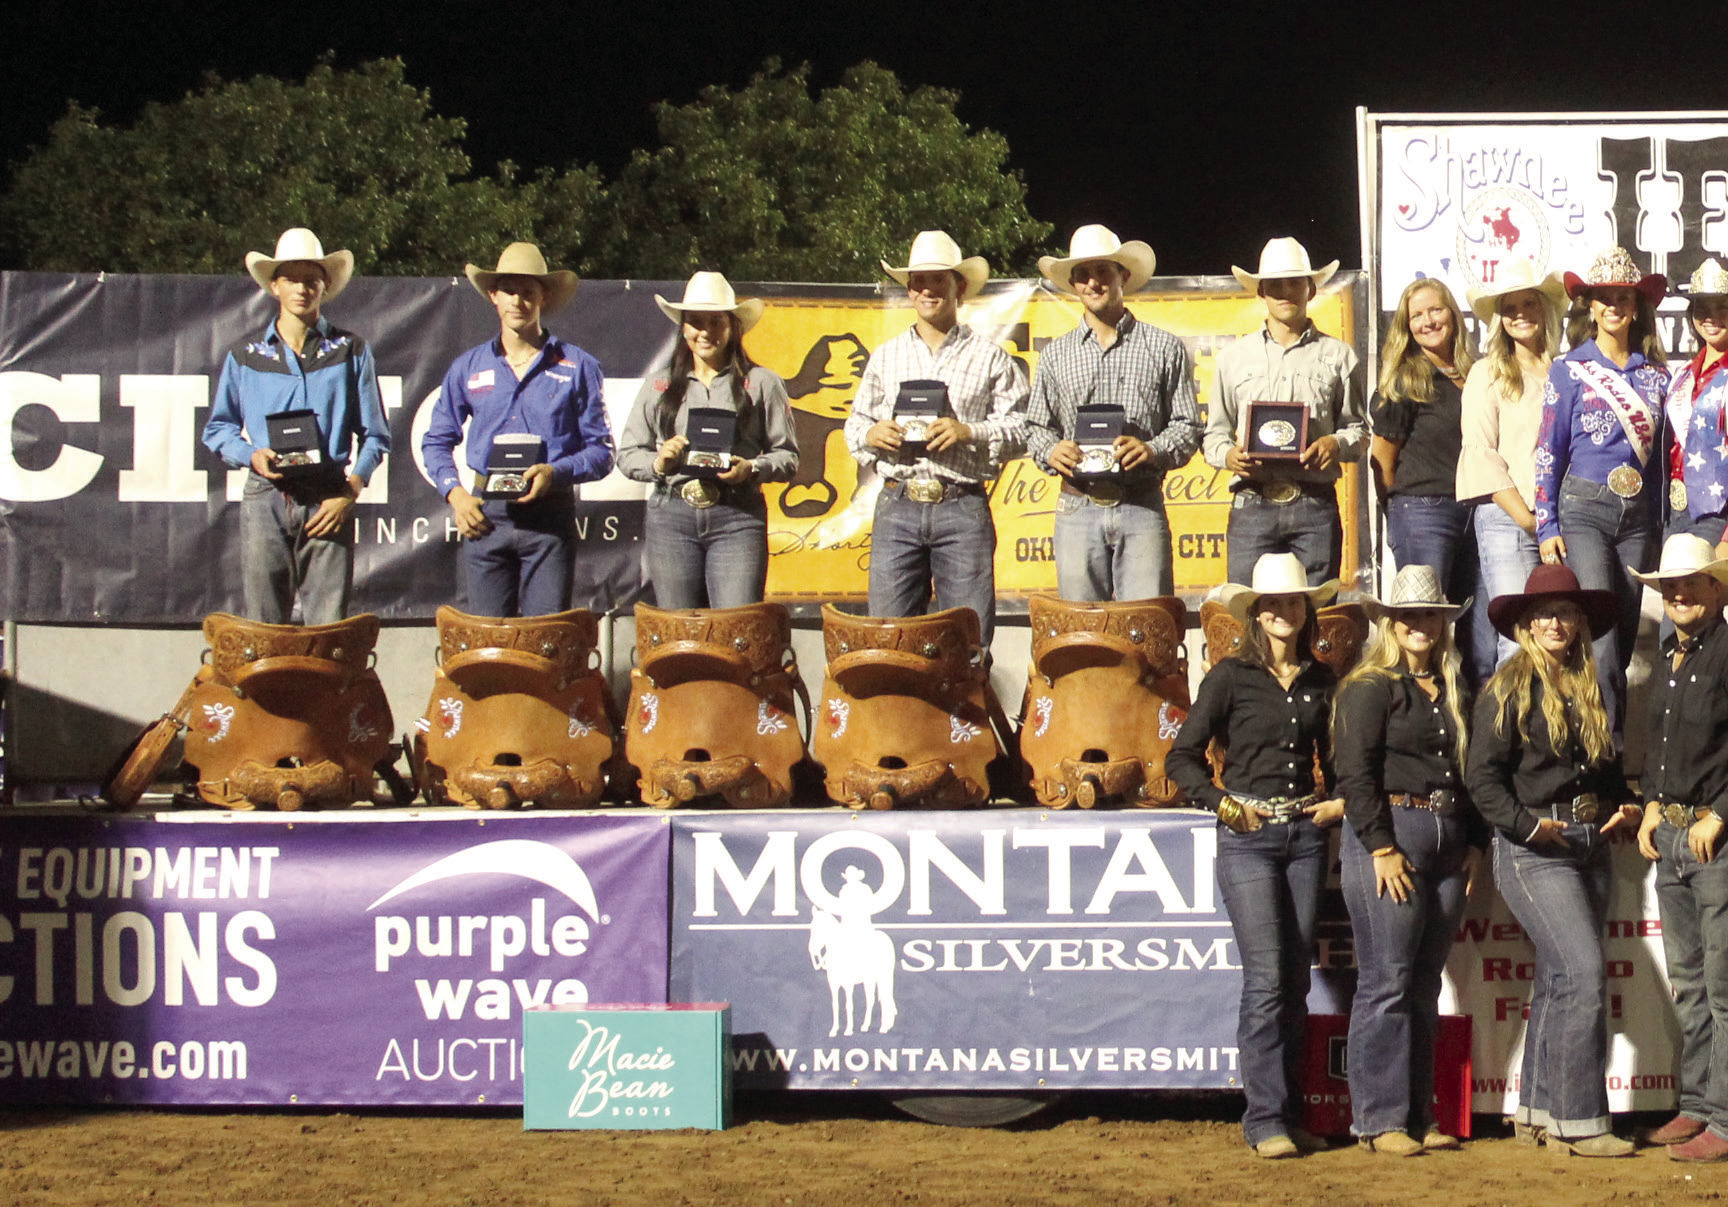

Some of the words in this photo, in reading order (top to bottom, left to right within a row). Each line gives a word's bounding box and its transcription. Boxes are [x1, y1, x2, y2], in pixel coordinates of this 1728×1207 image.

[1394, 135, 1585, 243] Shawnee
[1178, 533, 1226, 559] CIT
[17, 847, 280, 906] EQUIPMENT
[692, 826, 1218, 918] MONTA
[375, 898, 591, 973] purple
[1454, 919, 1663, 943] Weme
[1483, 957, 1634, 982] Roo
[415, 979, 590, 1021] wave
[568, 1019, 675, 1076] Macie
[569, 1069, 674, 1119] Bean
[612, 1107, 671, 1117] BOOTS
